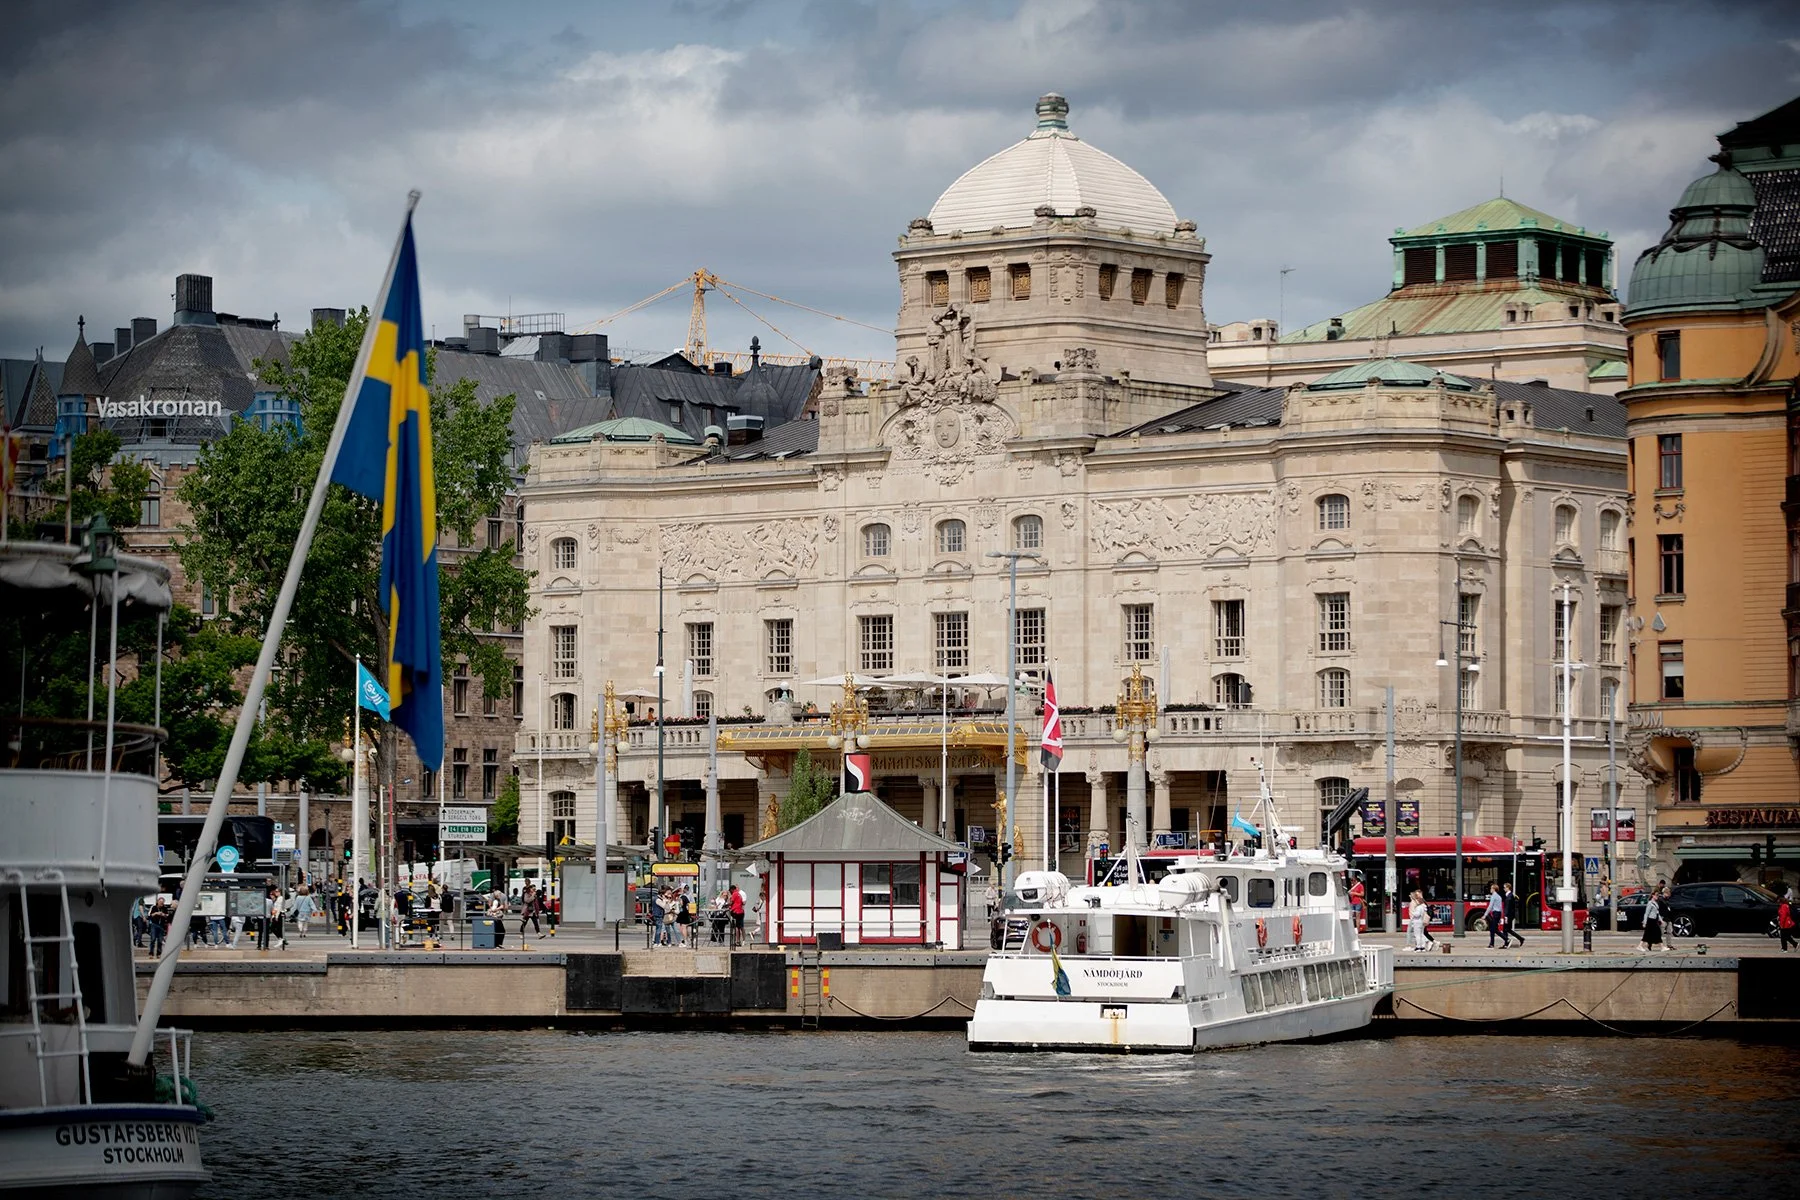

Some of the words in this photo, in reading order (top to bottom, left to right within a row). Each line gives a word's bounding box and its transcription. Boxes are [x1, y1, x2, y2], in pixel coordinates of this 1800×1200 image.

[96, 395, 221, 418] Vasakronan
[872, 755, 940, 770] RAMATISKA
[1083, 967, 1143, 980] NÄMDÖFJÄRD
[55, 1124, 181, 1145] GUSTAFSBERG
[103, 1147, 185, 1164] STOCKHOLM
